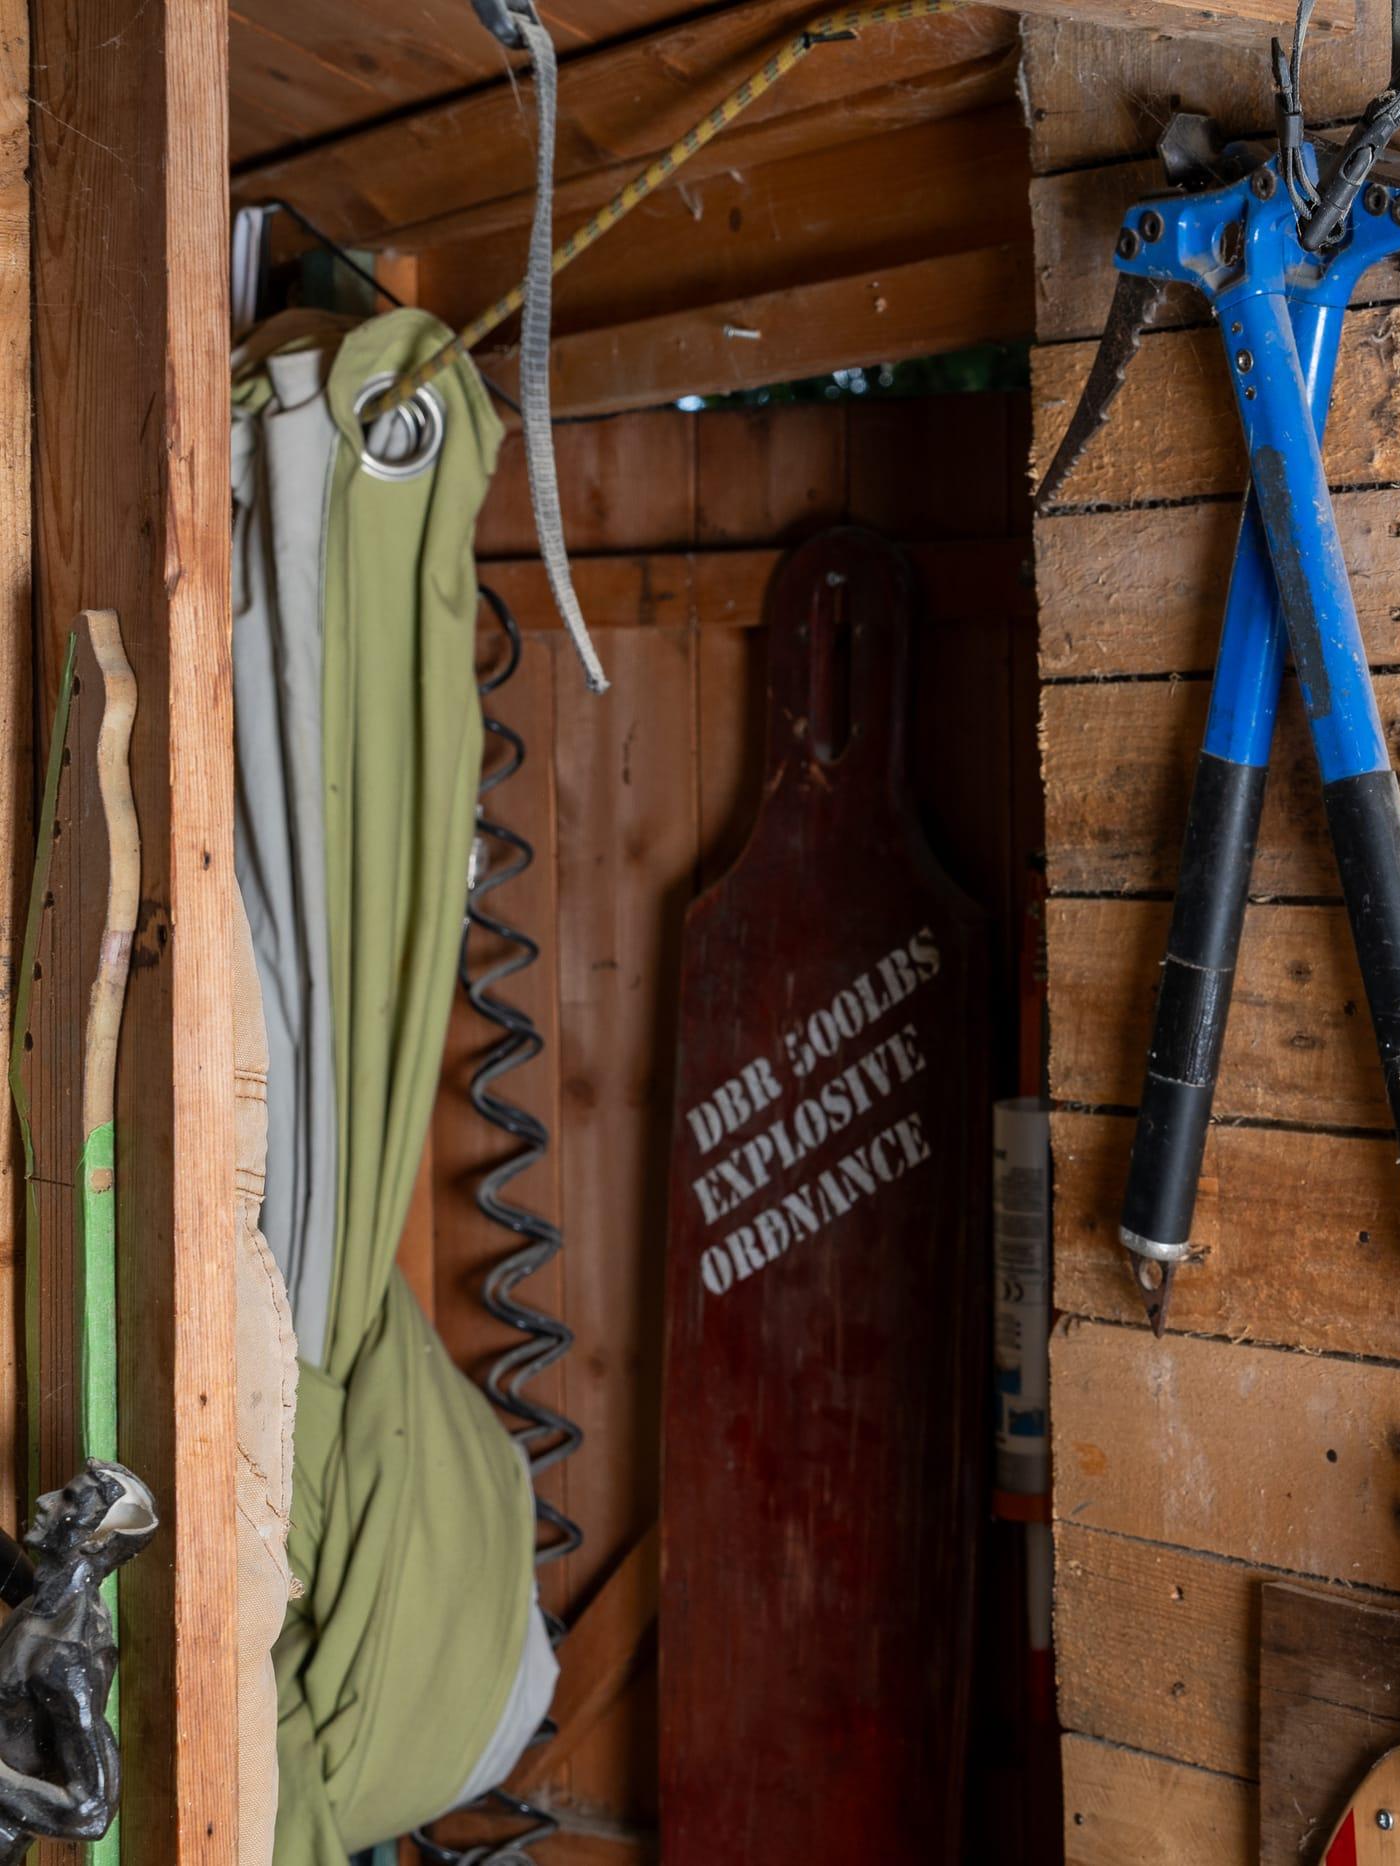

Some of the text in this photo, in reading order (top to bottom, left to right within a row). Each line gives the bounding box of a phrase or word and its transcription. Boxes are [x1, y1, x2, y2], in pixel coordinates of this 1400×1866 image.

[686, 1056, 783, 1155] DBR
[691, 1024, 927, 1226] EXPLOSIVE
[699, 1112, 932, 1296] ORDNANCE
